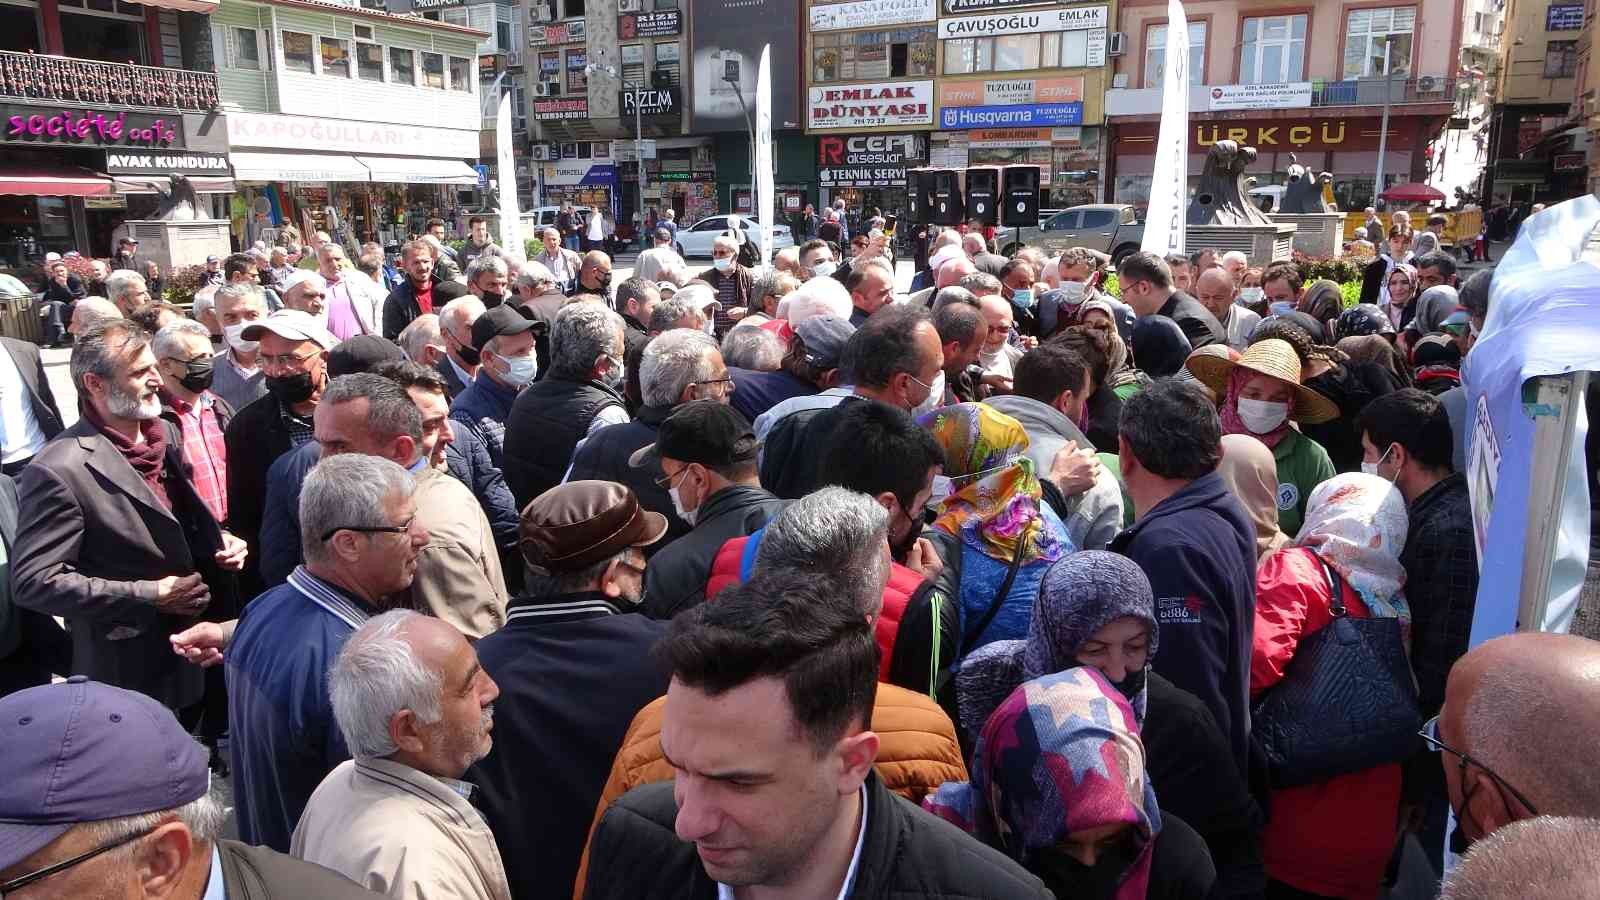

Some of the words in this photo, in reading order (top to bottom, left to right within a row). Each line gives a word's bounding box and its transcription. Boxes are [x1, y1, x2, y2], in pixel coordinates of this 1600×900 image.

[946, 16, 1039, 36] ÇAVUŞOĞLU
[1058, 9, 1099, 21] EMLAK
[825, 86, 915, 102] EMLAK
[1040, 87, 1077, 97] STIHL
[813, 103, 928, 120] DÜNYASI
[960, 109, 1032, 125] Husqvarna
[233, 117, 405, 146] KAPOĞULLARI
[1197, 121, 1346, 148] ÜRKÇÜ
[108, 154, 151, 169] AYAK
[155, 155, 228, 170] KUNDURA
[847, 153, 902, 164] aksesuar
[831, 167, 872, 180] TEKNİK
[874, 166, 907, 179] SERVİ
